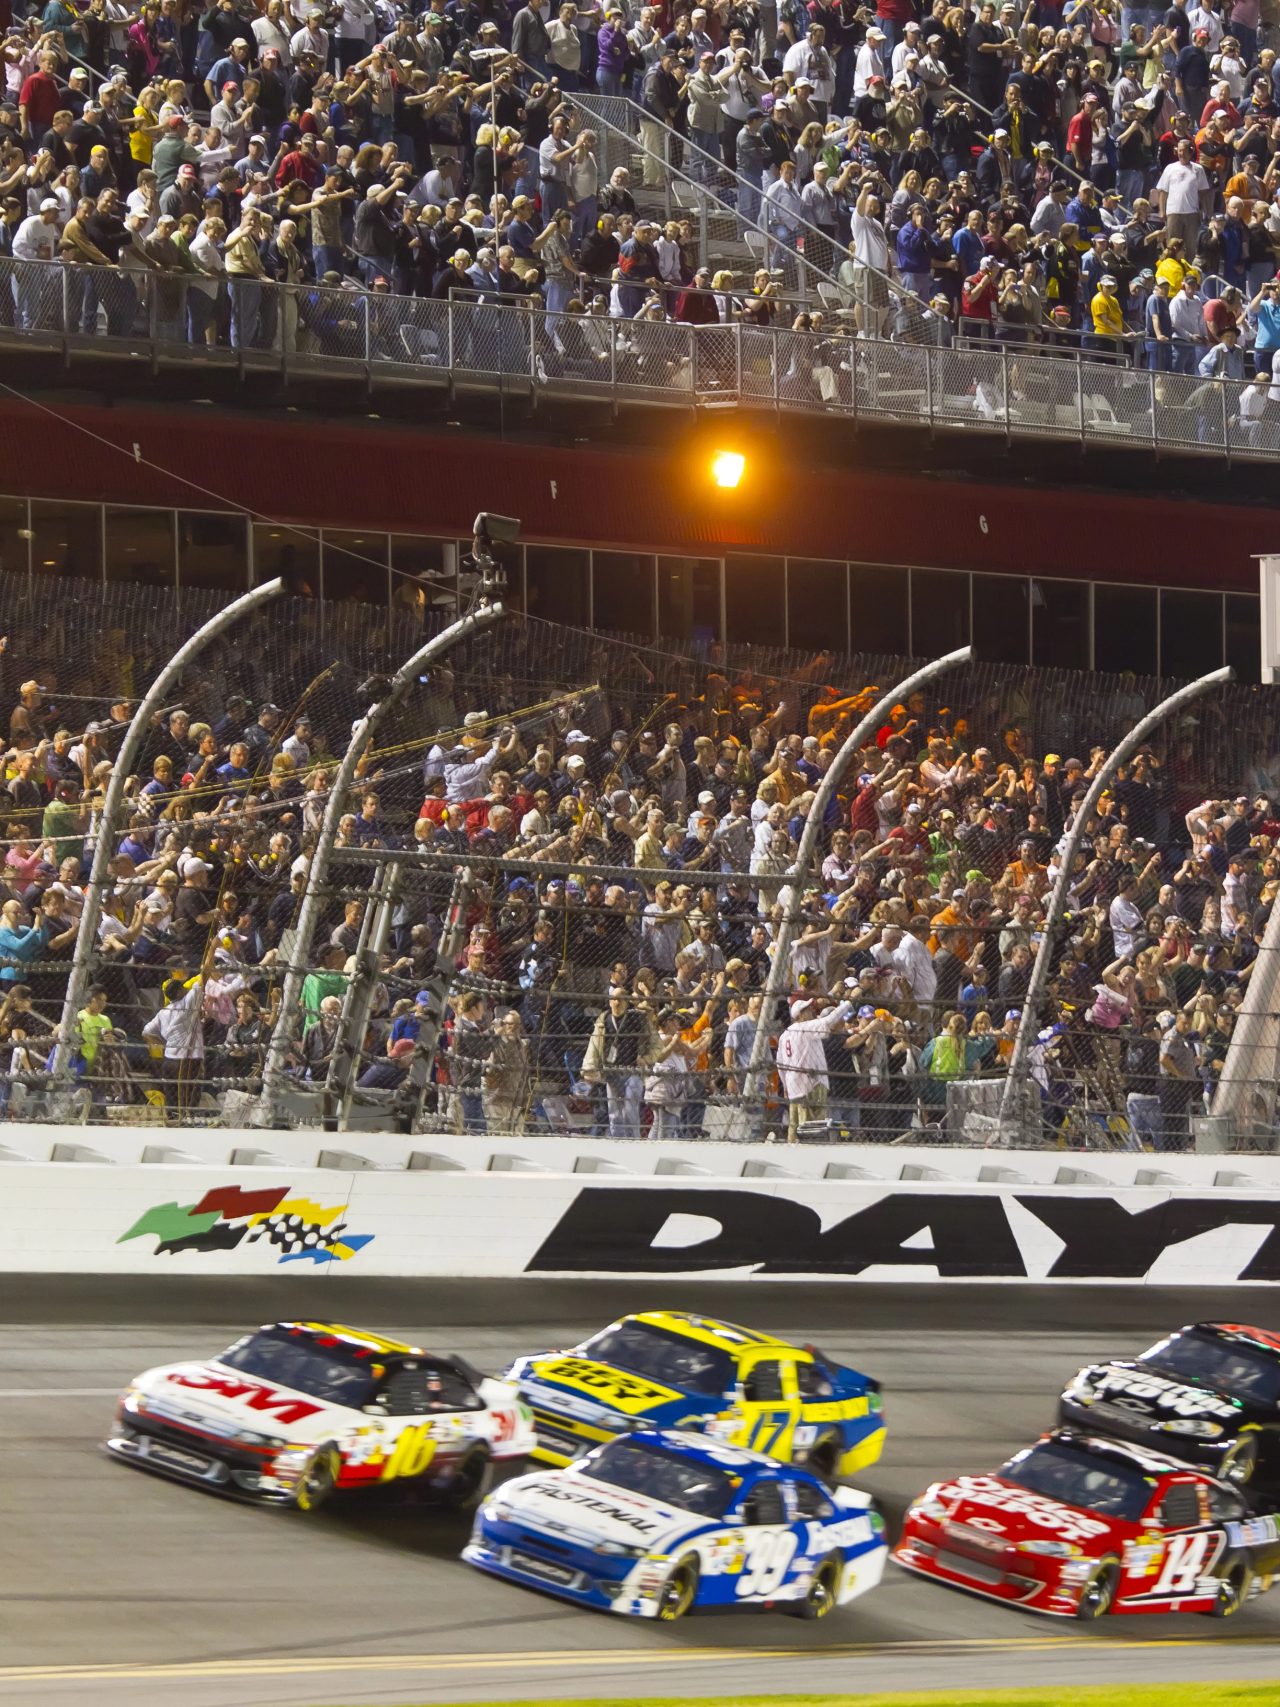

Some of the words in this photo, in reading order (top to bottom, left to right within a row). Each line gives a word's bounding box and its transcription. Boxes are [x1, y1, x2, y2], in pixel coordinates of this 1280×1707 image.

[133, 443, 141, 463] F
[550, 480, 557, 499] F
[979, 515, 989, 534] G
[167, 1373, 326, 1424] 3M
[548, 1366, 642, 1399] BUY
[749, 1409, 791, 1454] 17
[518, 1483, 658, 1535] FASTENAL
[735, 1530, 799, 1596] 99
[1150, 1532, 1208, 1594] 14
